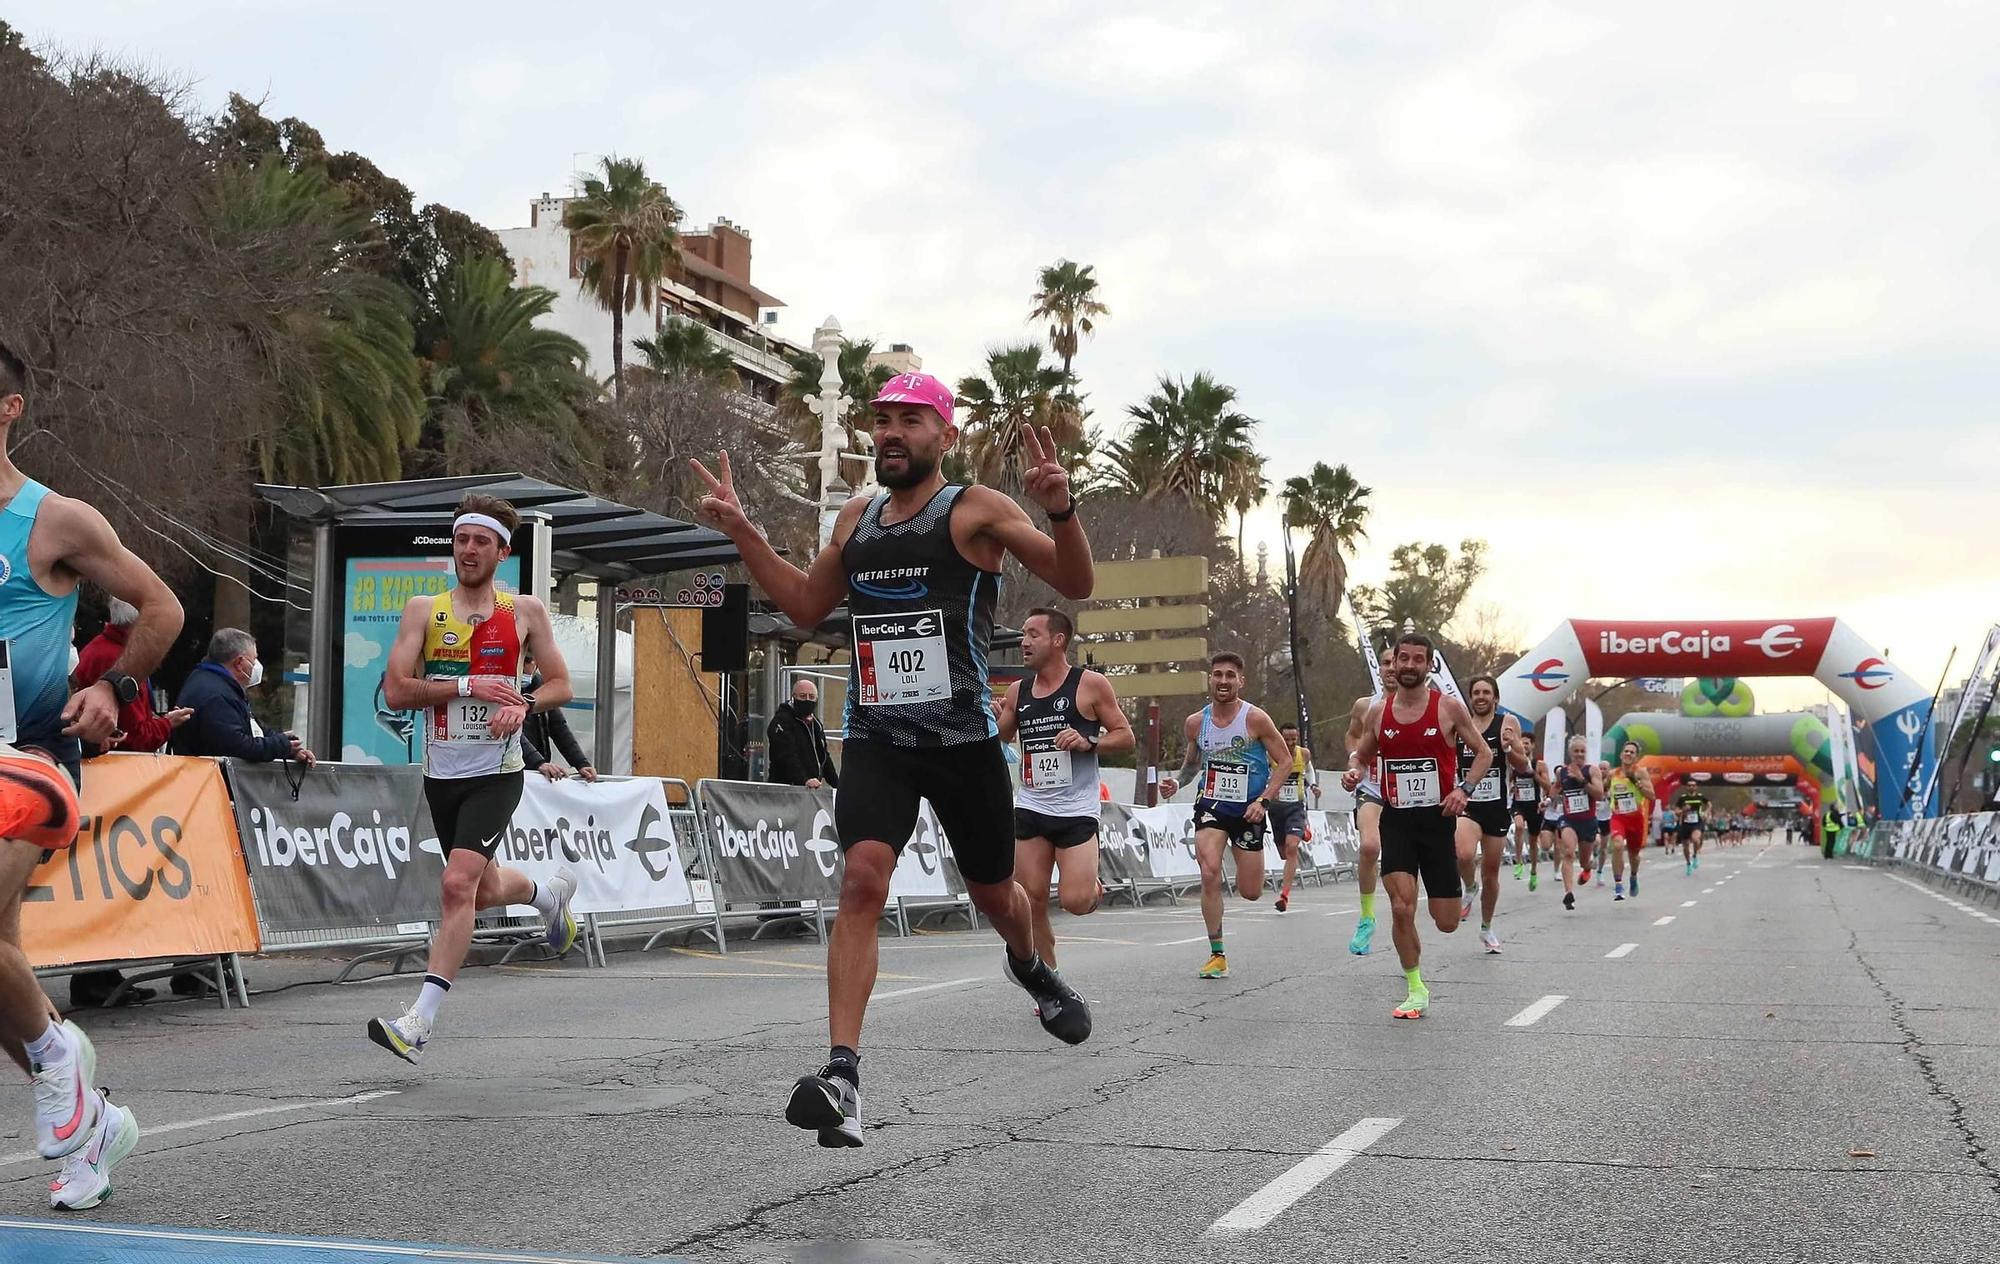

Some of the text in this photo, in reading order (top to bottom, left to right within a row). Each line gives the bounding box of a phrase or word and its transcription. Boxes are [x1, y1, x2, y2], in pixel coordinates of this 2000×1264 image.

[903, 373, 923, 390] T
[412, 536, 453, 545] JCDecaux
[696, 577, 705, 585] 95
[856, 567, 929, 582] METAESPORT
[680, 593, 689, 601] 26
[695, 593, 704, 602] 70
[711, 593, 720, 602] 94
[861, 622, 905, 636] iberCaja
[1600, 629, 1730, 659] iberCaja
[889, 649, 926, 674] 402
[901, 674, 918, 684] LOLI
[866, 684, 875, 697] 01
[461, 705, 488, 722] 132
[1031, 715, 1065, 726] ATLETISMO
[462, 722, 487, 730] LOUISON
[1039, 758, 1059, 772] 424
[1390, 763, 1417, 771] iberCaja
[1221, 777, 1238, 789] 313
[1406, 778, 1426, 792] 127
[250, 806, 411, 880] iberCaja
[715, 815, 800, 870] iberCaja
